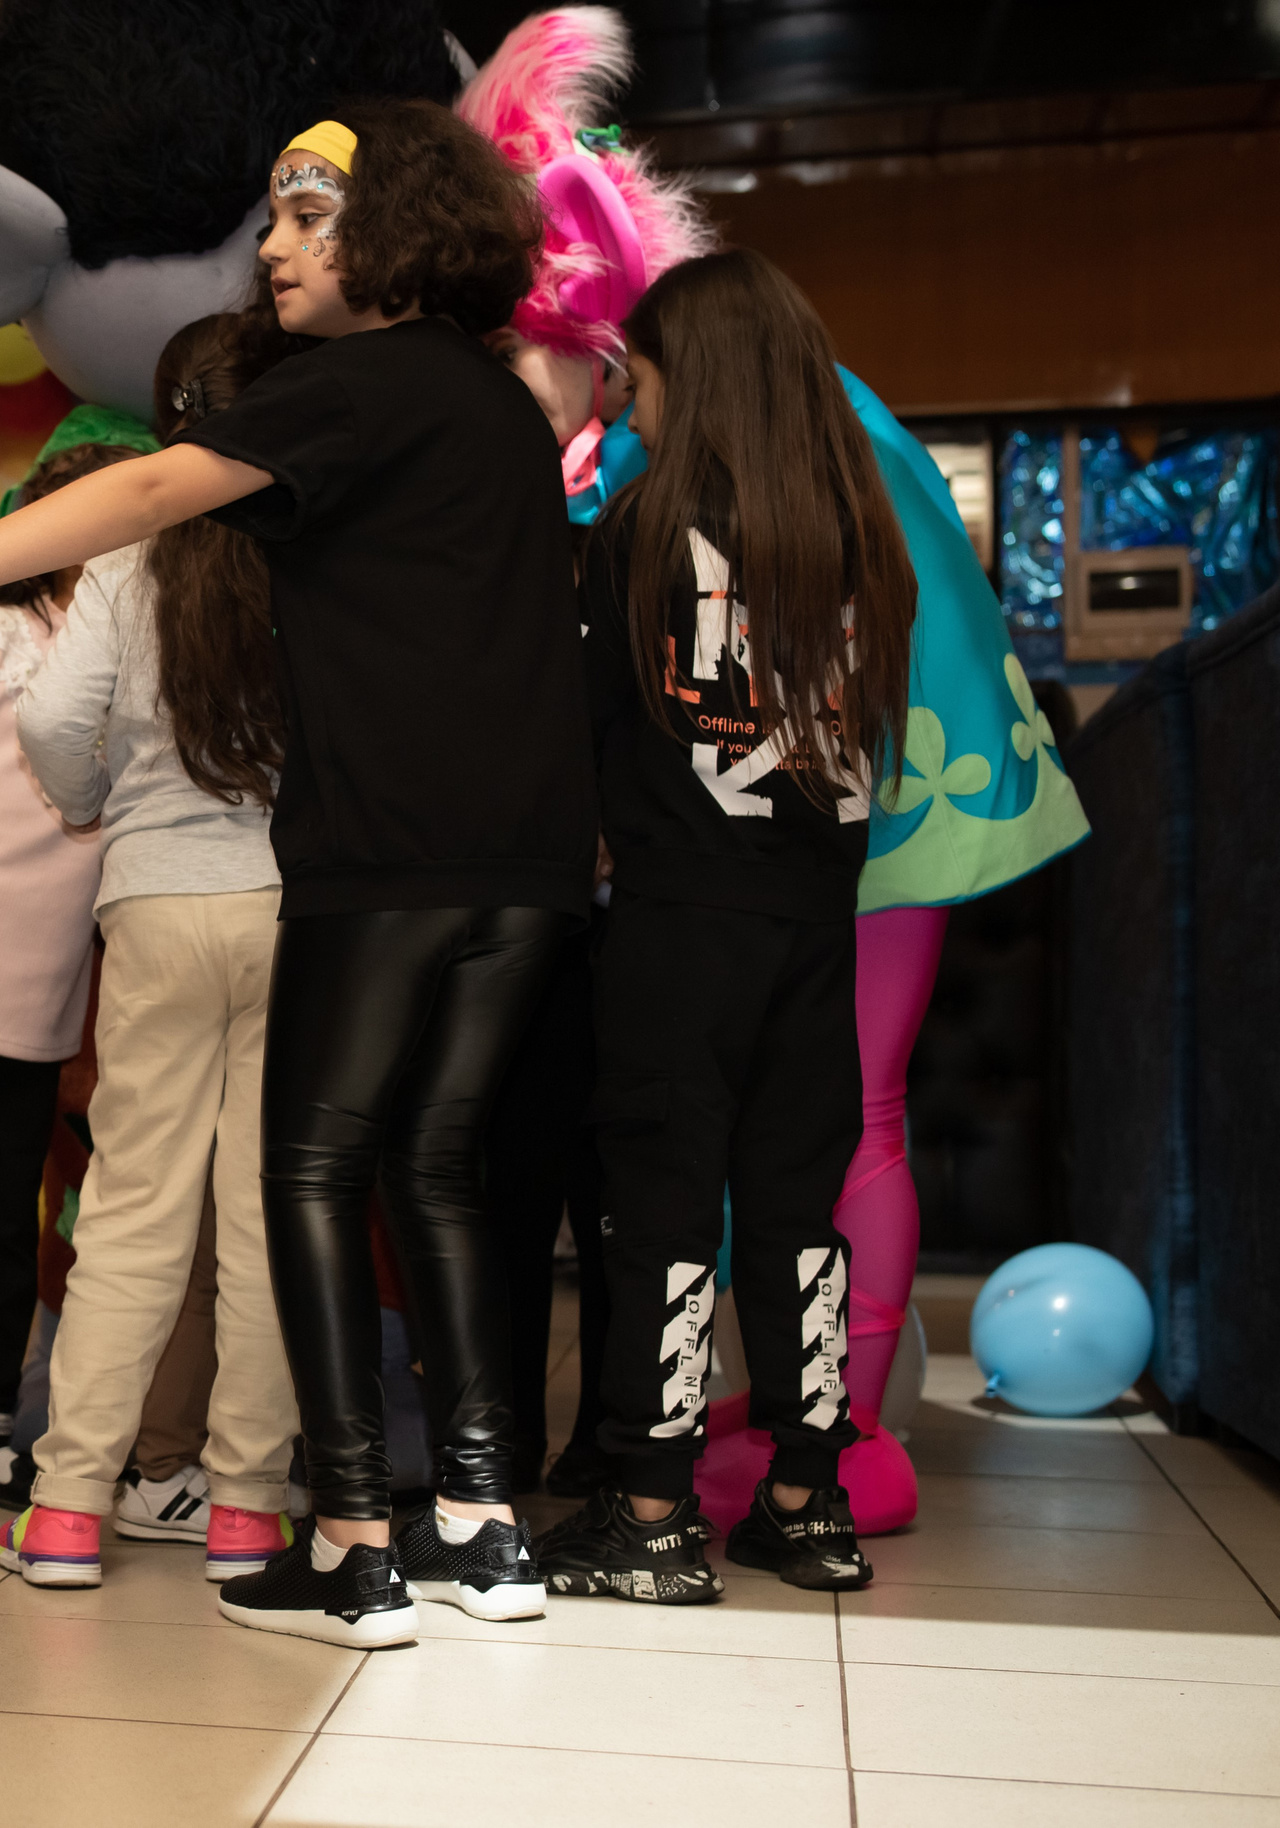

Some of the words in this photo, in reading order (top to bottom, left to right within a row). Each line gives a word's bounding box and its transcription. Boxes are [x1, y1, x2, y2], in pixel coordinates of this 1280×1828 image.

[698, 715, 755, 734] Offline
[728, 743, 752, 754] you
[680, 1300, 700, 1406] OFFLNE
[821, 1283, 837, 1390] OFFLINE
